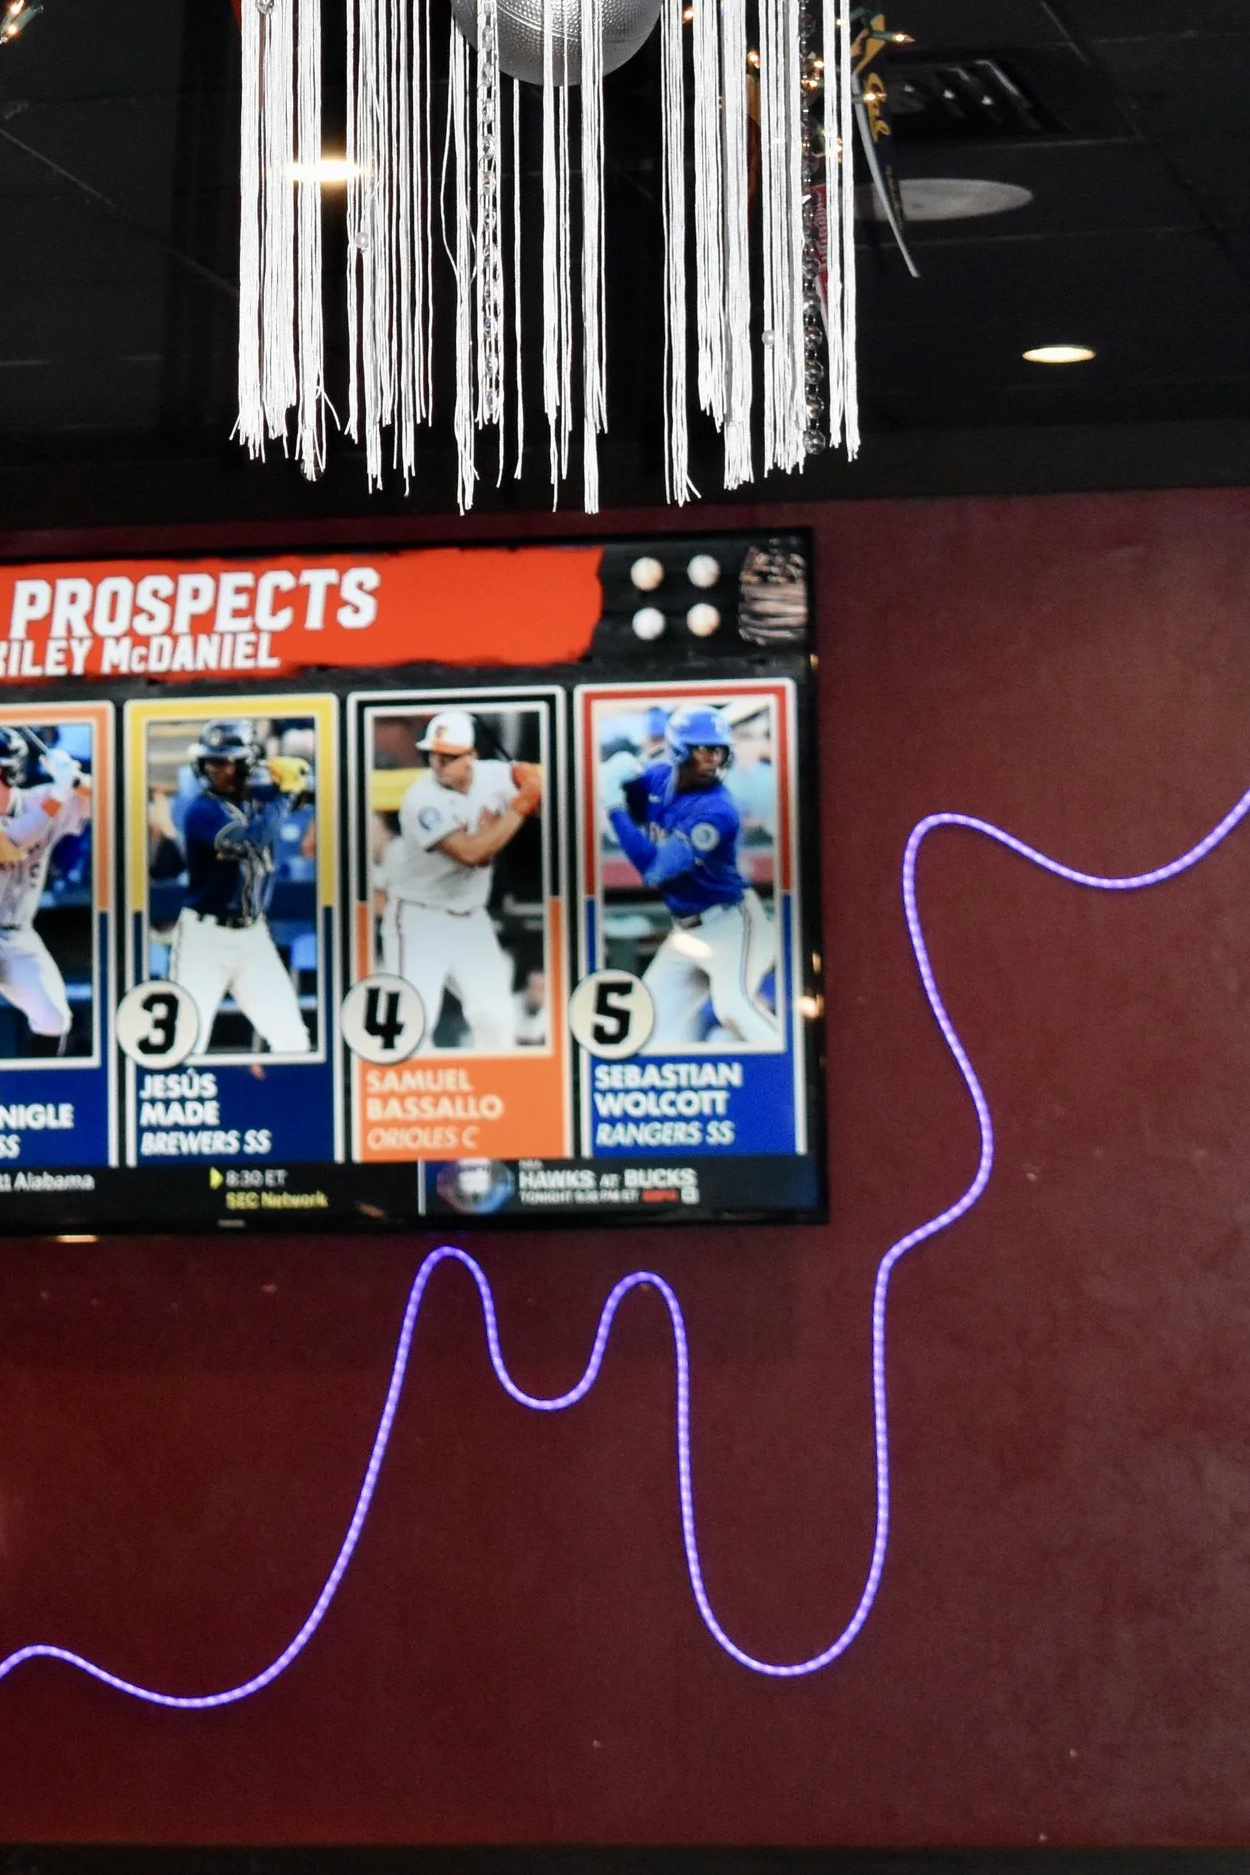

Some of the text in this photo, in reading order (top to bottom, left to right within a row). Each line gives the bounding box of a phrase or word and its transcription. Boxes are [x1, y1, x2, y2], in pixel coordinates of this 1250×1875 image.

[10, 566, 381, 642] PROSPECTS
[100, 629, 281, 675] McDANIEL
[137, 992, 182, 1056] 3
[362, 986, 405, 1050] 4
[593, 981, 634, 1046] 5
[366, 1068, 474, 1094] SAMUEL
[594, 1062, 743, 1090] SEBASTIAN
[139, 1100, 220, 1128] MADE
[366, 1094, 504, 1123] BASSALLO
[140, 1128, 273, 1157] BREWERS SS
[366, 1125, 480, 1151] ORIOLES C
[595, 1120, 736, 1148] RANGERS SS
[13, 1171, 95, 1193] Alabama
[518, 1167, 699, 1190] HAWKS AT BUCKS
[225, 1190, 330, 1210] SEC Network
